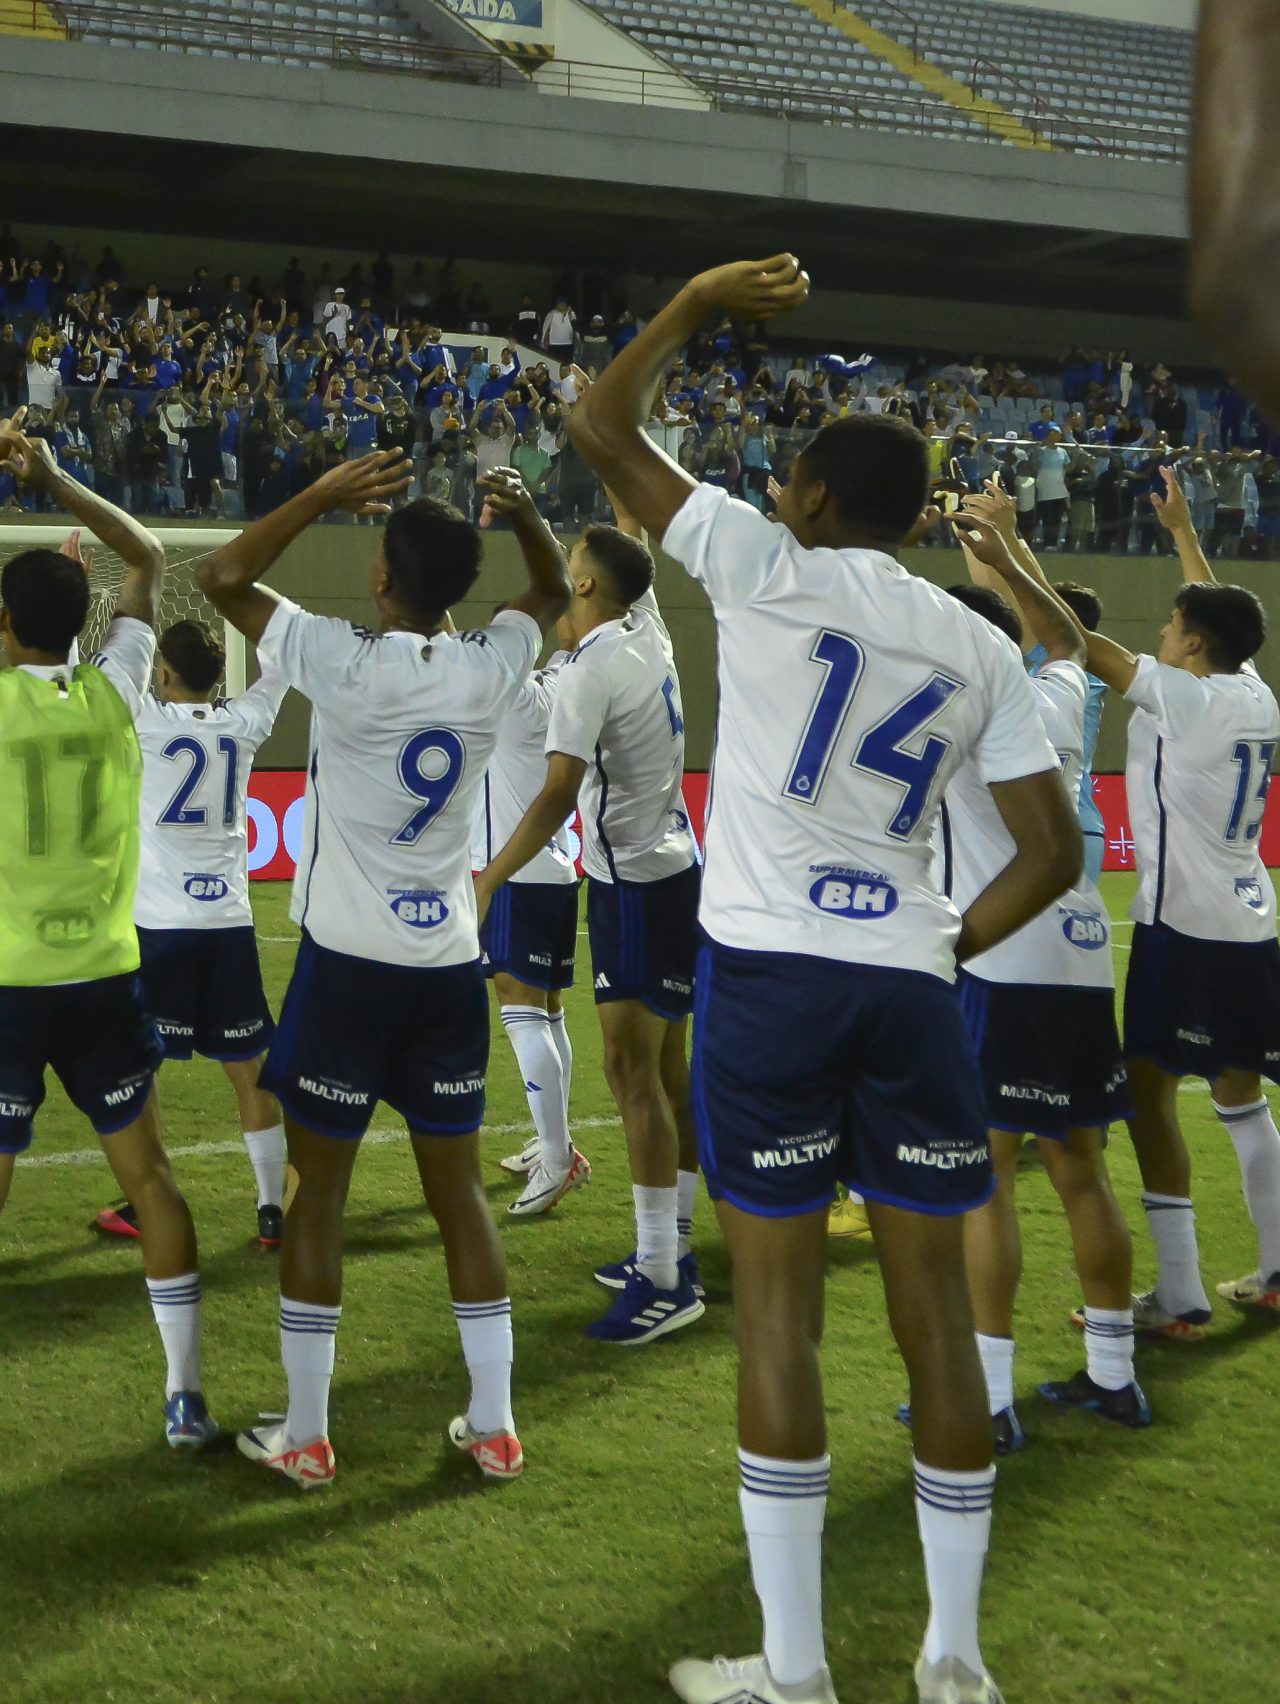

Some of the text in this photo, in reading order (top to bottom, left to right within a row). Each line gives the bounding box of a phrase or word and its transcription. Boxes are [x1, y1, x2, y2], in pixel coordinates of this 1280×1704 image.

[781, 627, 967, 843] 14
[156, 734, 240, 826] 21
[389, 725, 466, 847] 9
[7, 731, 113, 860] 17
[189, 881, 223, 896] BH
[820, 881, 889, 912] BH
[398, 901, 441, 922] BH
[1071, 920, 1104, 942] BH
[299, 1076, 369, 1105] MULTIVIX
[1000, 1084, 1071, 1106] MULTIVIX
